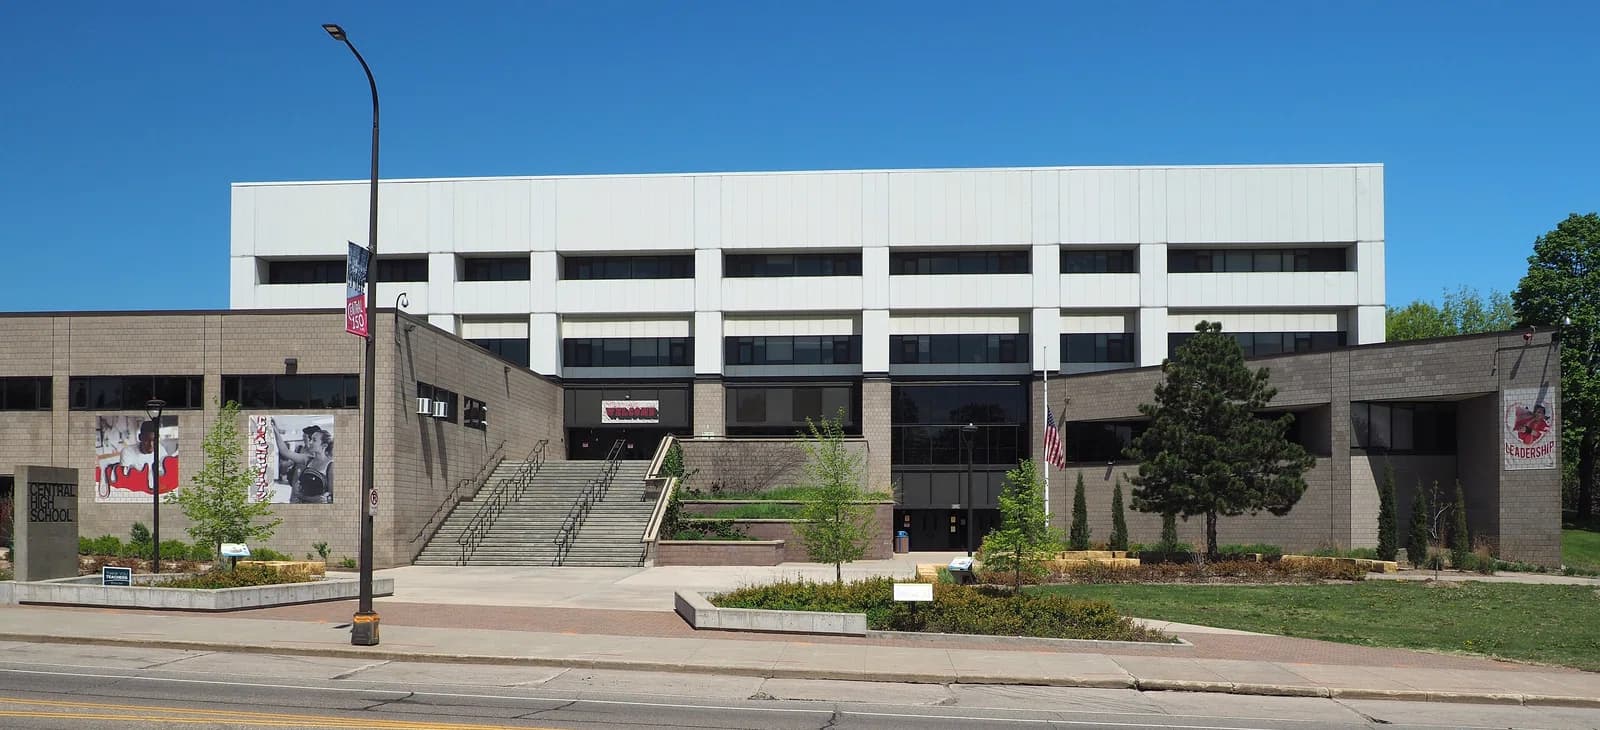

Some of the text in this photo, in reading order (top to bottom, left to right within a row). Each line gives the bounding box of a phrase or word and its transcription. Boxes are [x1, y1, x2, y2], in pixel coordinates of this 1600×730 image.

[352, 313, 365, 330] 150
[1505, 440, 1555, 459] LEADERSHIP
[30, 483, 77, 497] CENTRAL
[30, 495, 55, 509] HIGH
[30, 508, 73, 522] SCHOOL
